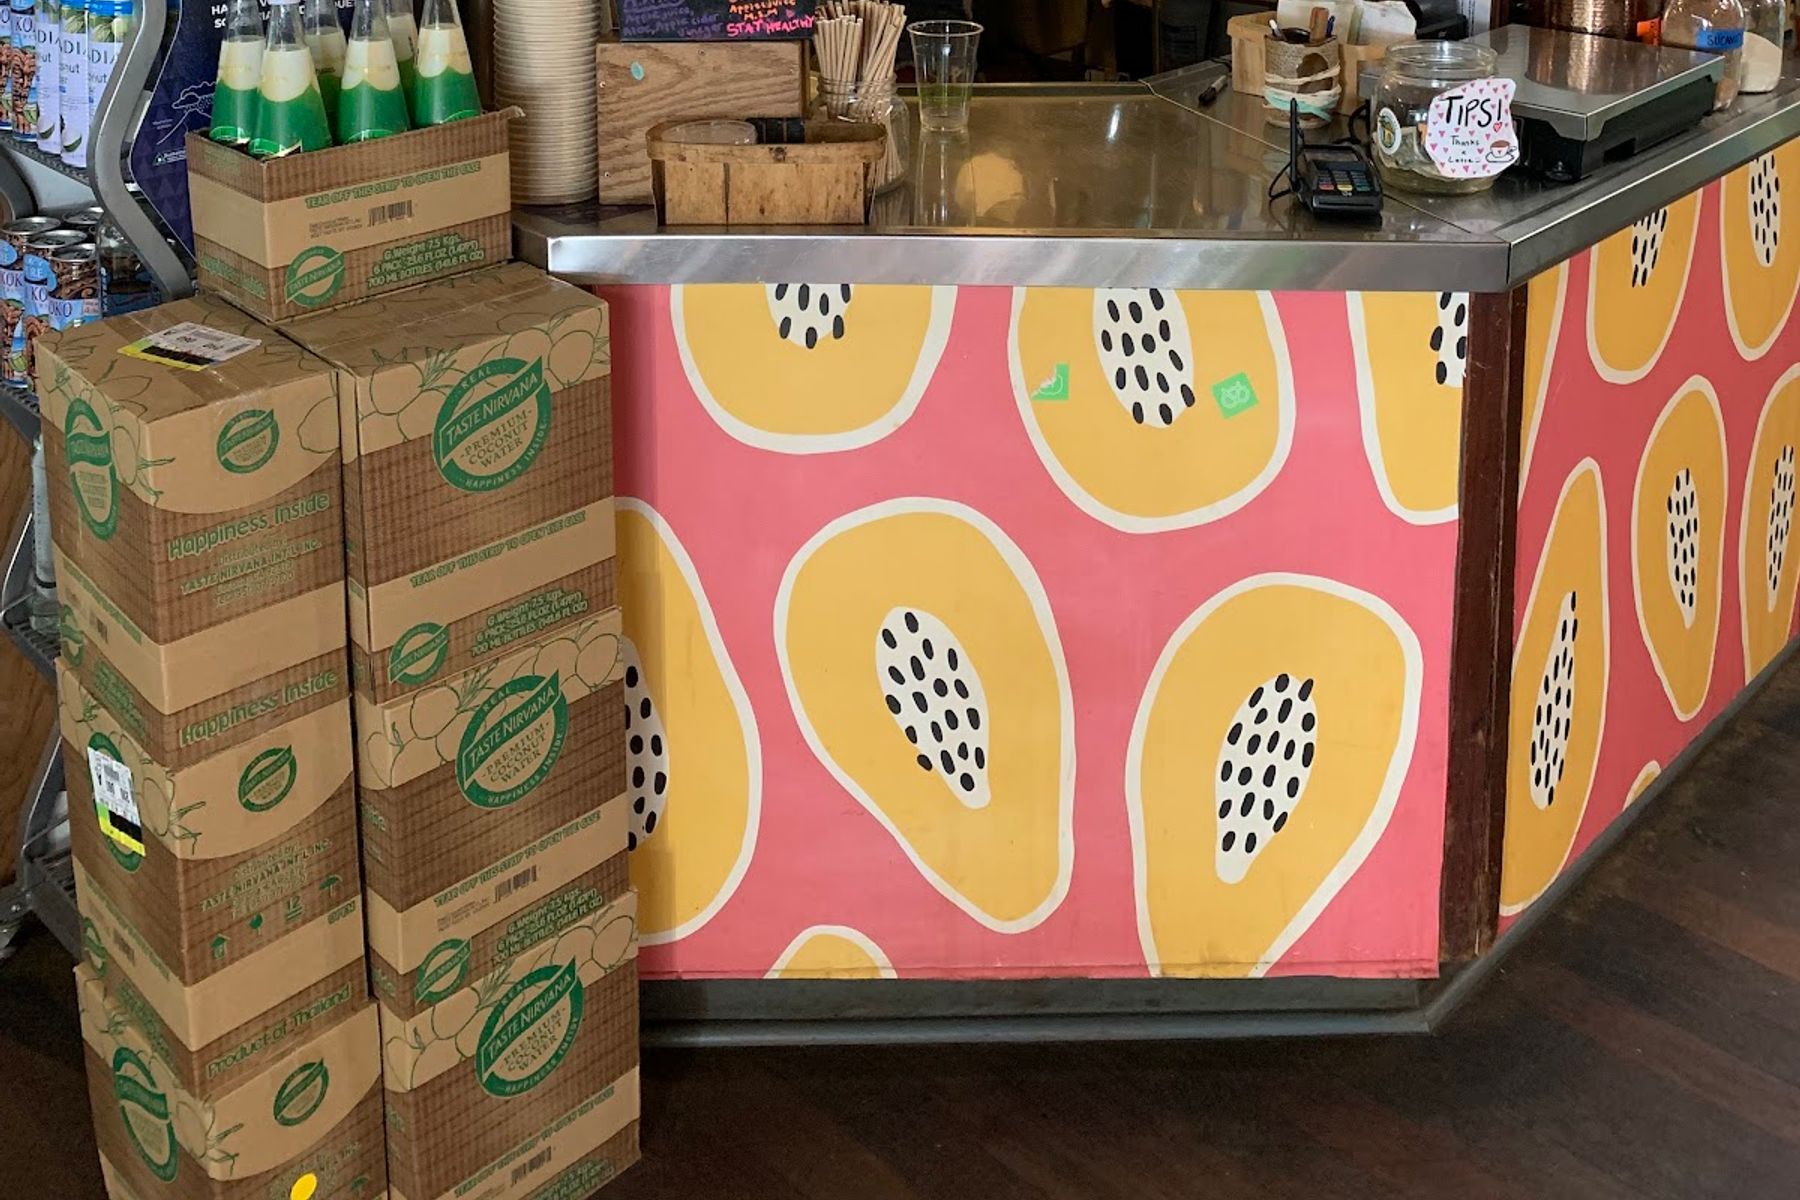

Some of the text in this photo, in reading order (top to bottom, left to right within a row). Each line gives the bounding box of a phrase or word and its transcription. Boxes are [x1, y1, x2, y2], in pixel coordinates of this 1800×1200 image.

[446, 372, 539, 446] TASTE NIRVANA
[468, 422, 529, 466] COCONUT
[480, 437, 523, 469] WATER
[167, 513, 269, 562] Happiness
[206, 1035, 270, 1080] Product
